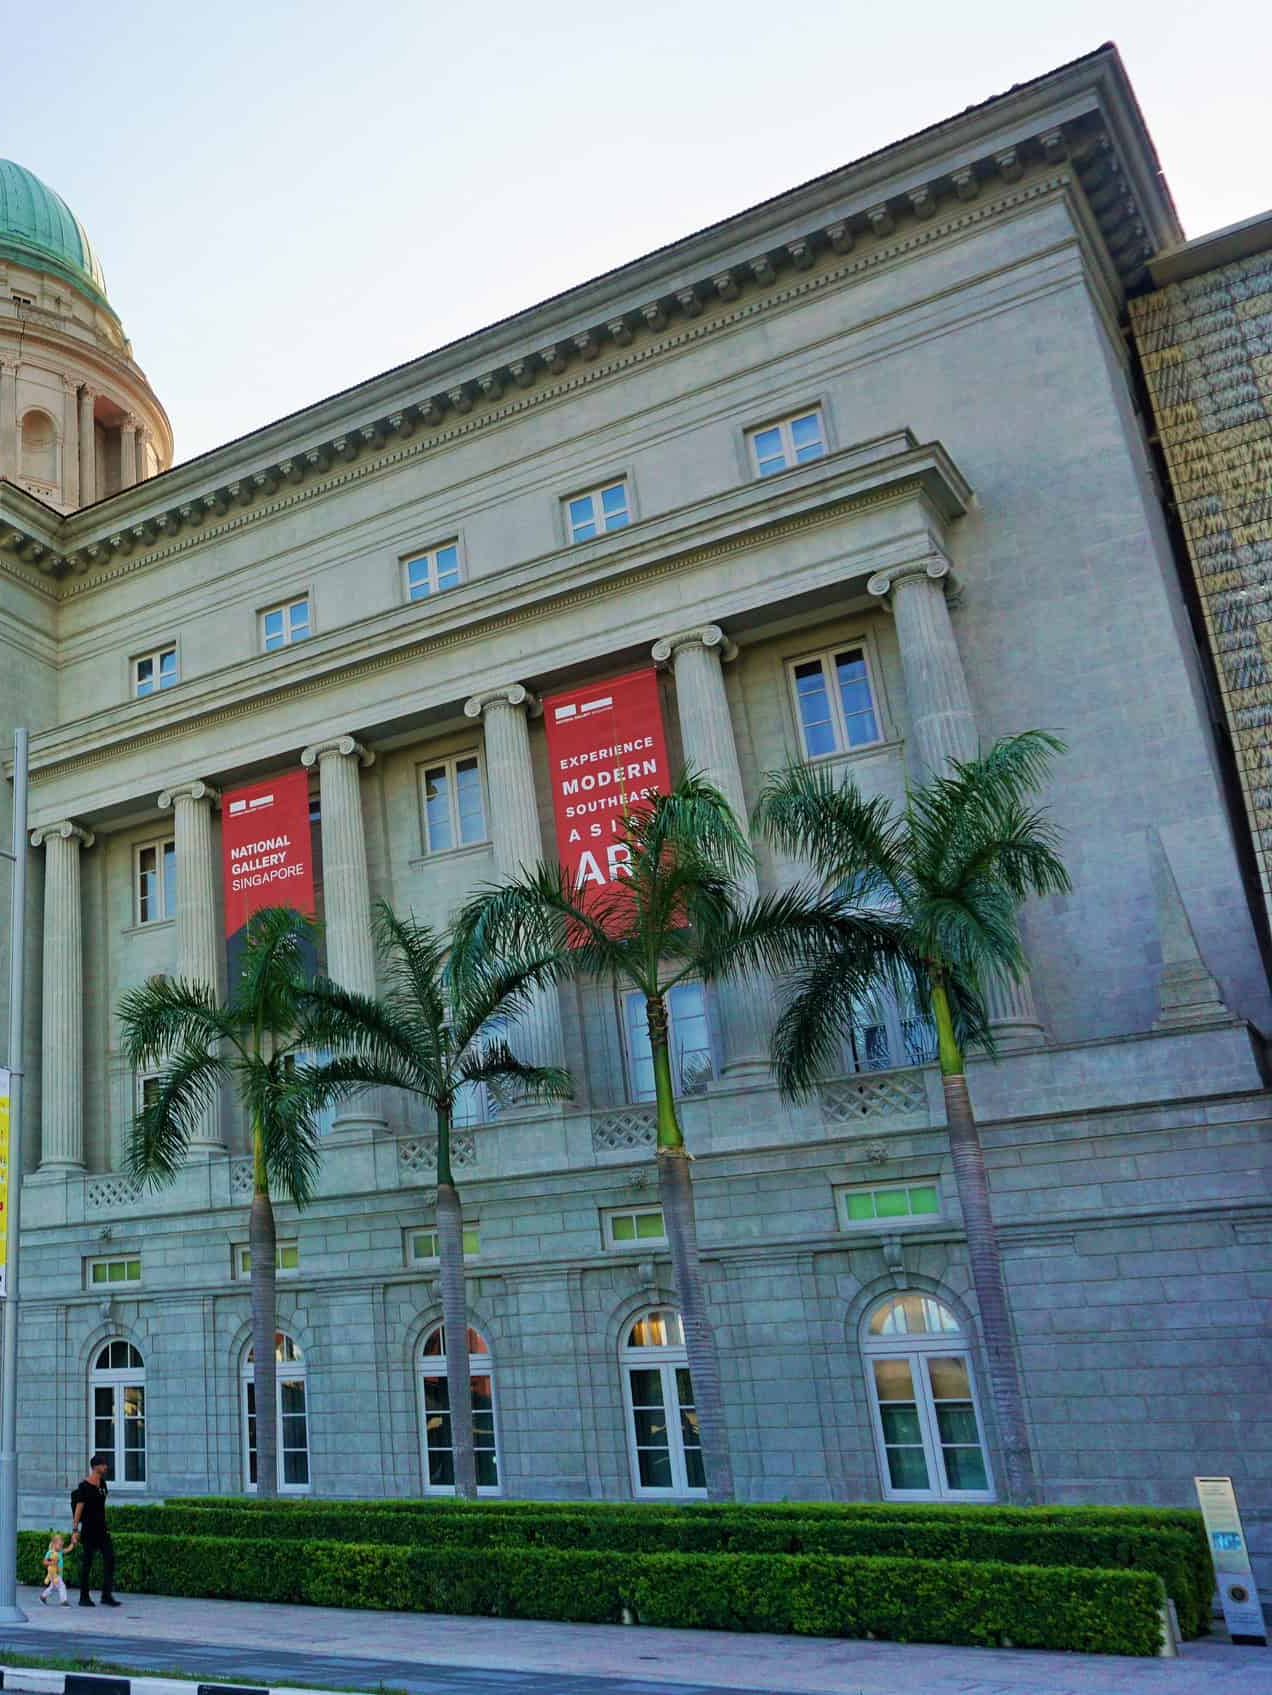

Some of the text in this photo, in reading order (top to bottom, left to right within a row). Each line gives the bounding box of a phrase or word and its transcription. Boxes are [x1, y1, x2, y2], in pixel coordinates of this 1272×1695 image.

[560, 736, 654, 771] EXPERIENCE
[562, 758, 658, 797] MODERN
[231, 834, 292, 861] NATIONAL
[232, 851, 288, 875] GALLERY
[232, 863, 305, 892] SINGAPORE
[574, 837, 657, 891] AR
